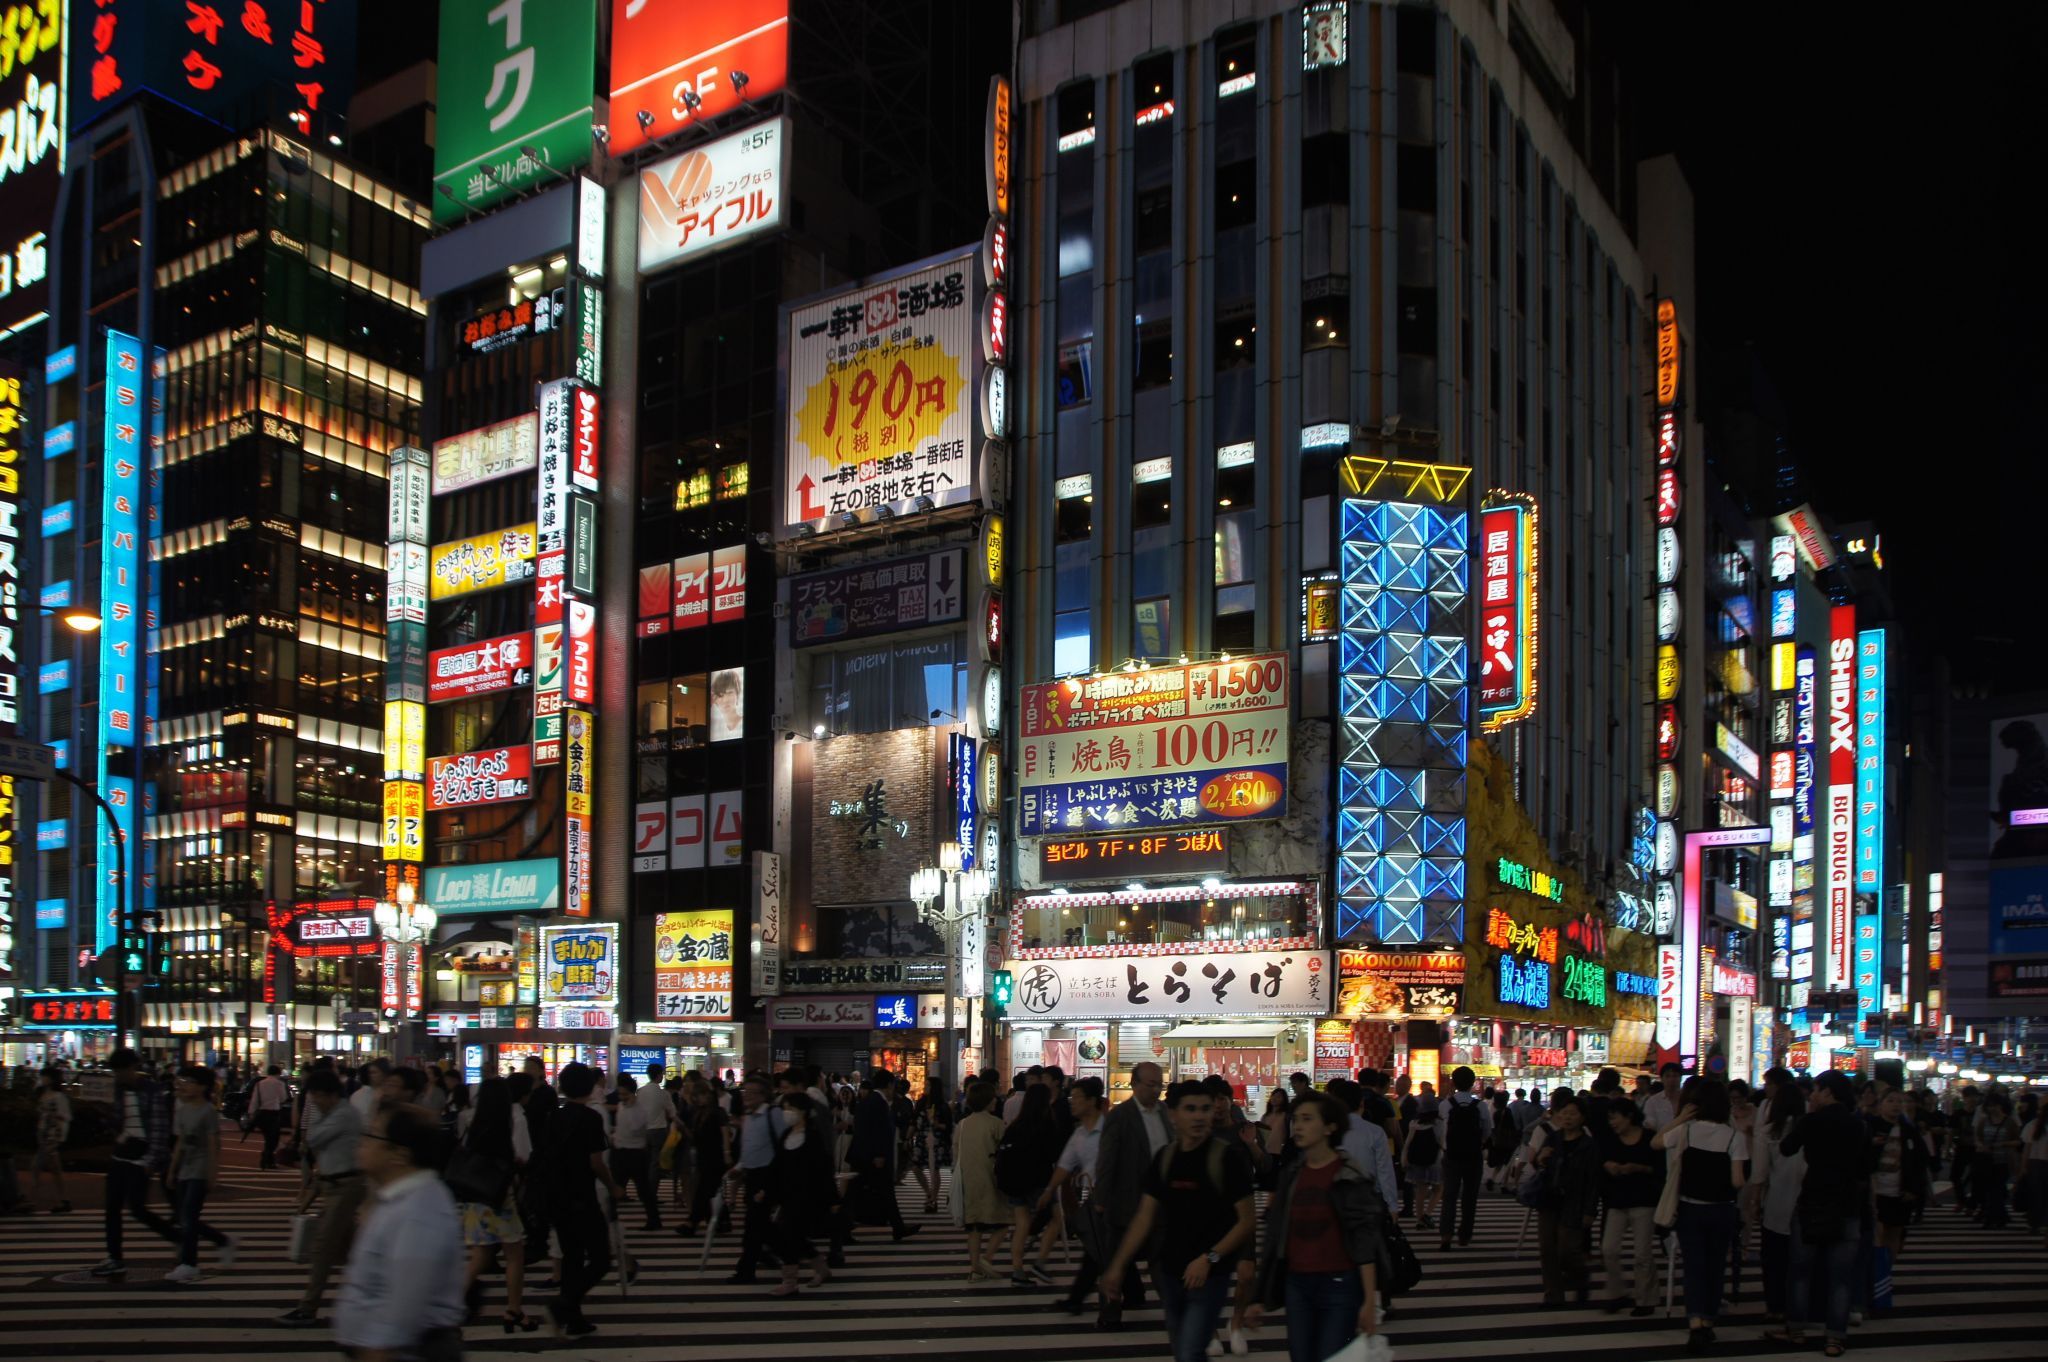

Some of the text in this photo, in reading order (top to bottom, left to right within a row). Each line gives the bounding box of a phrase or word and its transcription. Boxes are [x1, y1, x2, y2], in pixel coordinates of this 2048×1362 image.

[752, 130, 773, 148] 5F
[678, 169, 772, 211] キャッシングなら
[677, 189, 772, 247] アイフル
[823, 359, 946, 438] 190円
[579, 410, 595, 475] アイフル
[830, 470, 953, 515] 左の路地を右へ
[110, 351, 138, 731] カラオケ&パーティー館
[675, 564, 746, 598] アイフル
[798, 562, 926, 602] ブランド高価買取
[1487, 531, 1509, 601] 居酒屋
[675, 598, 708, 617] 新規会員
[900, 602, 925, 618] FREE
[901, 586, 924, 601] TAX
[933, 597, 957, 616] 1F
[647, 622, 661, 634] 5F
[438, 639, 521, 677] 居酒屋本陣
[1481, 615, 1514, 676] つぼ八
[513, 668, 530, 686] 4F
[574, 641, 588, 687] アコム
[1192, 660, 1283, 701] ¥1,500
[574, 688, 588, 699] 3F
[1045, 690, 1063, 729] つぼ八
[1830, 638, 1854, 754] SHIDAX
[1067, 701, 1186, 728] ポテトフライ食べ放題
[1024, 745, 1038, 778] 6F
[1071, 735, 1132, 774] 焼鳥
[1151, 720, 1279, 770] 100円!!
[433, 751, 508, 783] しゃぶしゃぶ
[568, 740, 585, 794] 金の蔵
[1861, 642, 1878, 884] カラオケ&パーティー館
[432, 778, 498, 805] うどんすき
[512, 778, 528, 796] 4F
[571, 797, 586, 810] 2F
[1067, 775, 1198, 803] しゃぶしゃぶ VS すきやき
[637, 803, 742, 851] アコム
[1024, 794, 1038, 828] 5F
[1066, 797, 1198, 828] 選べる食べ放題
[1047, 842, 1089, 862] 当ビル
[1175, 833, 1223, 851] つぼ八
[1832, 796, 1848, 882] BIC DRUG
[568, 820, 579, 909] 東京チカラめし
[643, 857, 659, 870] 3F
[762, 857, 778, 944] Roko Shira
[1834, 905, 1844, 939] CAMERA
[555, 939, 604, 961] まんが
[677, 932, 730, 962] 金の蔵
[1341, 953, 1466, 968] OKONOMI YAKI
[566, 964, 595, 983] 喫茶
[681, 971, 731, 989] 焼き牛丼
[1022, 965, 1060, 1012] 虎
[1068, 976, 1118, 991] 立ちそば
[1127, 956, 1292, 1006] とらそば
[1661, 950, 1676, 1010] トラノコ
[582, 1011, 610, 1028] 100円
[805, 1002, 864, 1023] Roko Shira
[621, 1049, 660, 1059] SUBNADE
